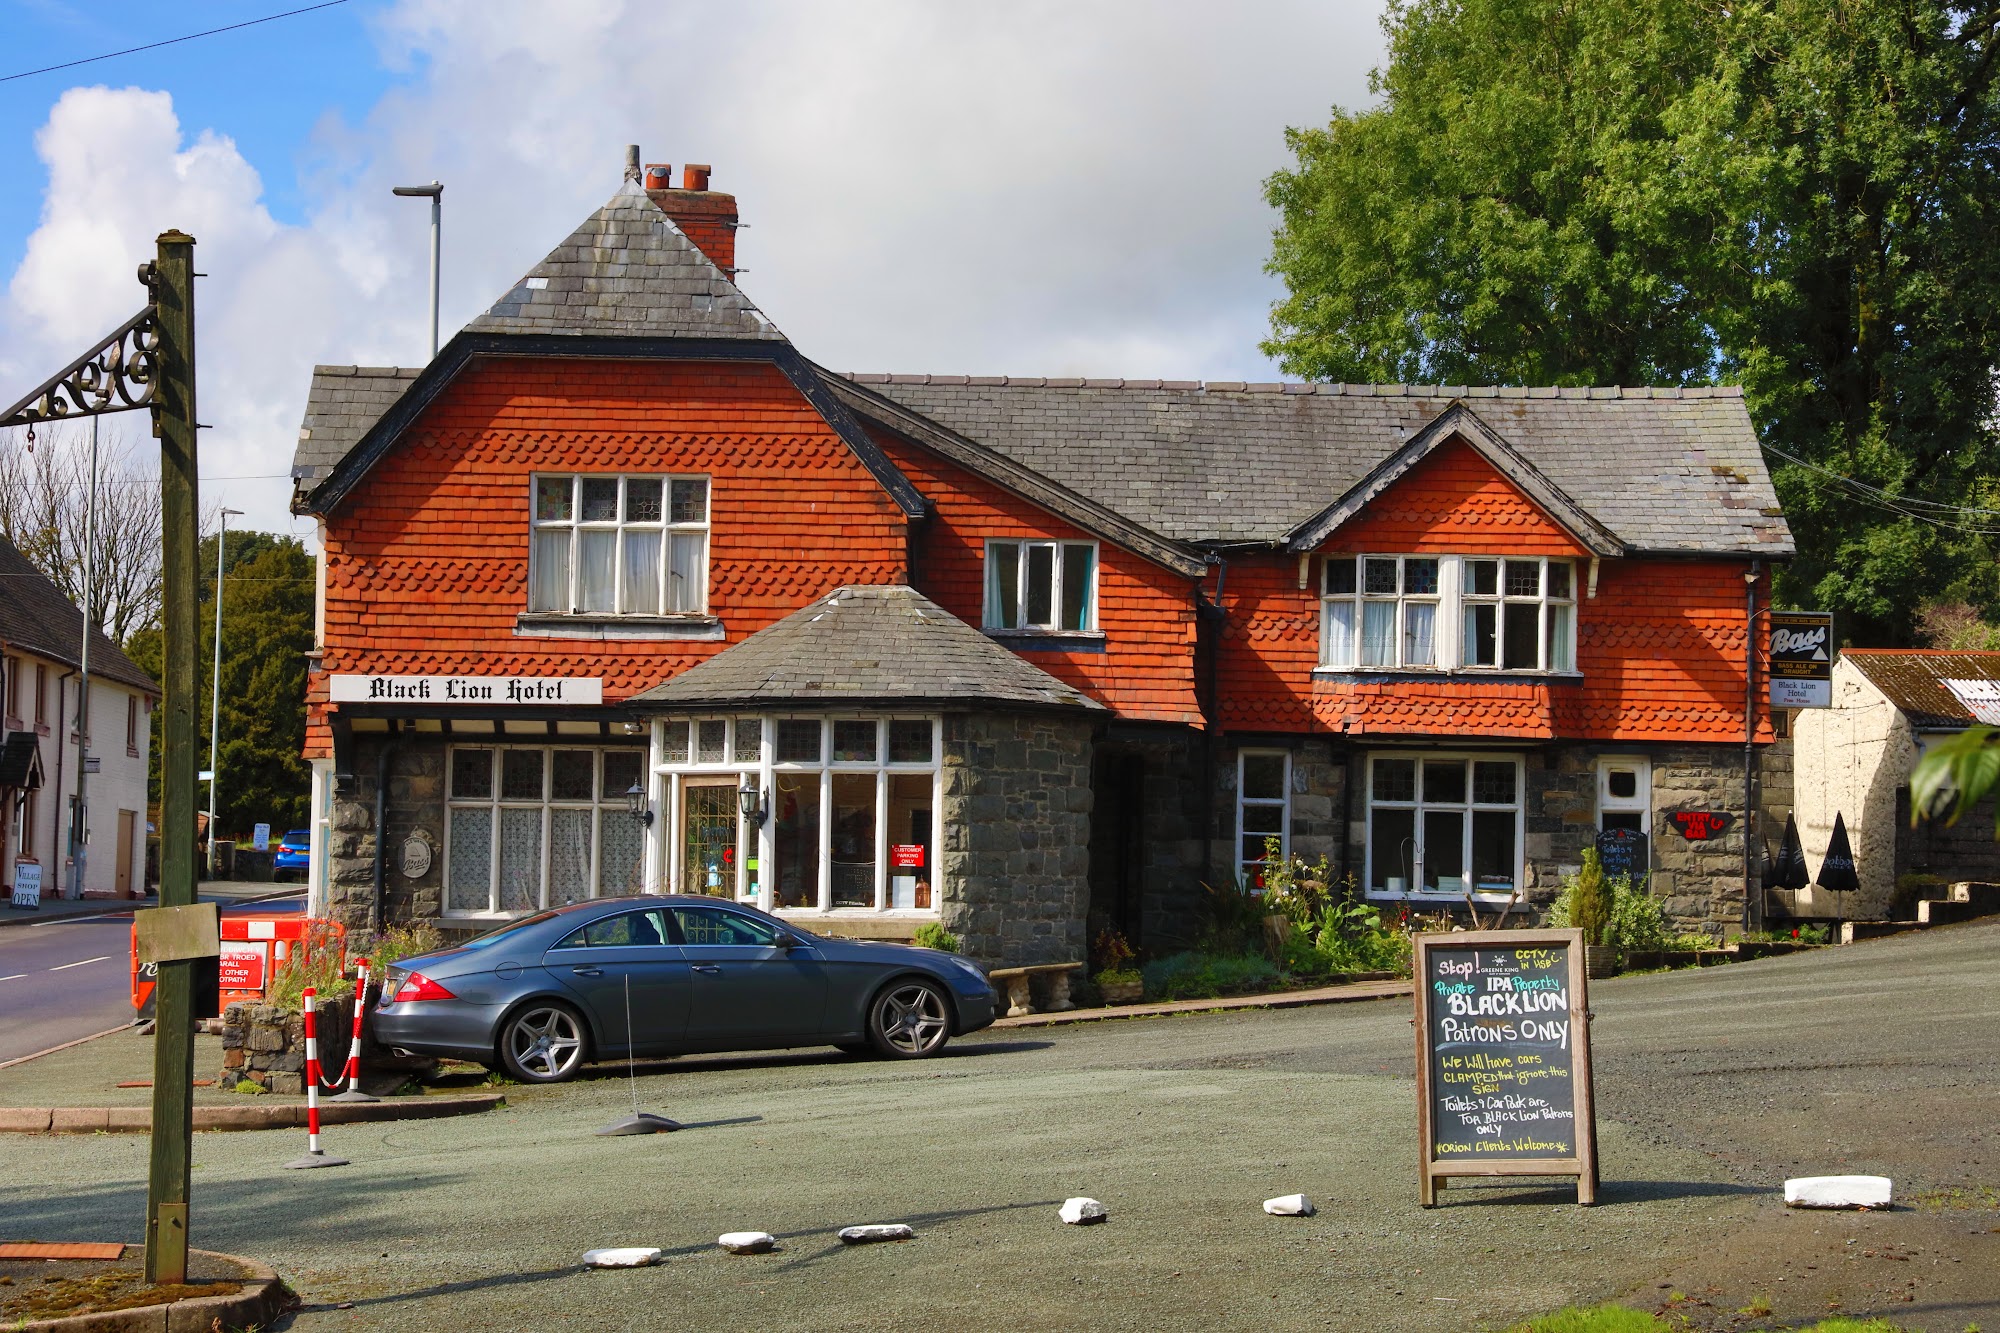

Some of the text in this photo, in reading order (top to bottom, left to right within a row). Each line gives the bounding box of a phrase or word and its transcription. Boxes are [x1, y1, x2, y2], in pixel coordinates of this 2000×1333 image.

[1770, 626, 1826, 656] Bass
[368, 677, 563, 703] Black Lion Hotel
[1778, 681, 1816, 690] Black Lion
[1788, 690, 1807, 698] Hotel
[1676, 811, 1711, 822] ENTRY
[1688, 820, 1706, 830] VIA
[1685, 829, 1707, 839] BAR
[403, 857, 429, 871] Bass
[13, 892, 39, 906] OPEN
[1515, 949, 1548, 960] CCTV
[1438, 951, 1481, 982] Stop!
[1434, 974, 1560, 996] Private Property
[1486, 977, 1514, 992] IPA
[1447, 992, 1523, 1016] BLACK
[1520, 1019, 1569, 1050] ONLY
[1484, 1053, 1513, 1070] have
[1517, 1054, 1543, 1065] cars
[1443, 1065, 1568, 1086] CLAMPED that ignore this
[1441, 1095, 1479, 1112] Toilets
[1486, 1096, 1504, 1110] Car
[1503, 1093, 1527, 1110] Park
[1528, 1097, 1550, 1109] are
[1482, 1110, 1518, 1125] BLACK
[1540, 1106, 1574, 1120] Patrons
[1475, 1124, 1502, 1138] ONLY
[1475, 1139, 1511, 1152] Clients
